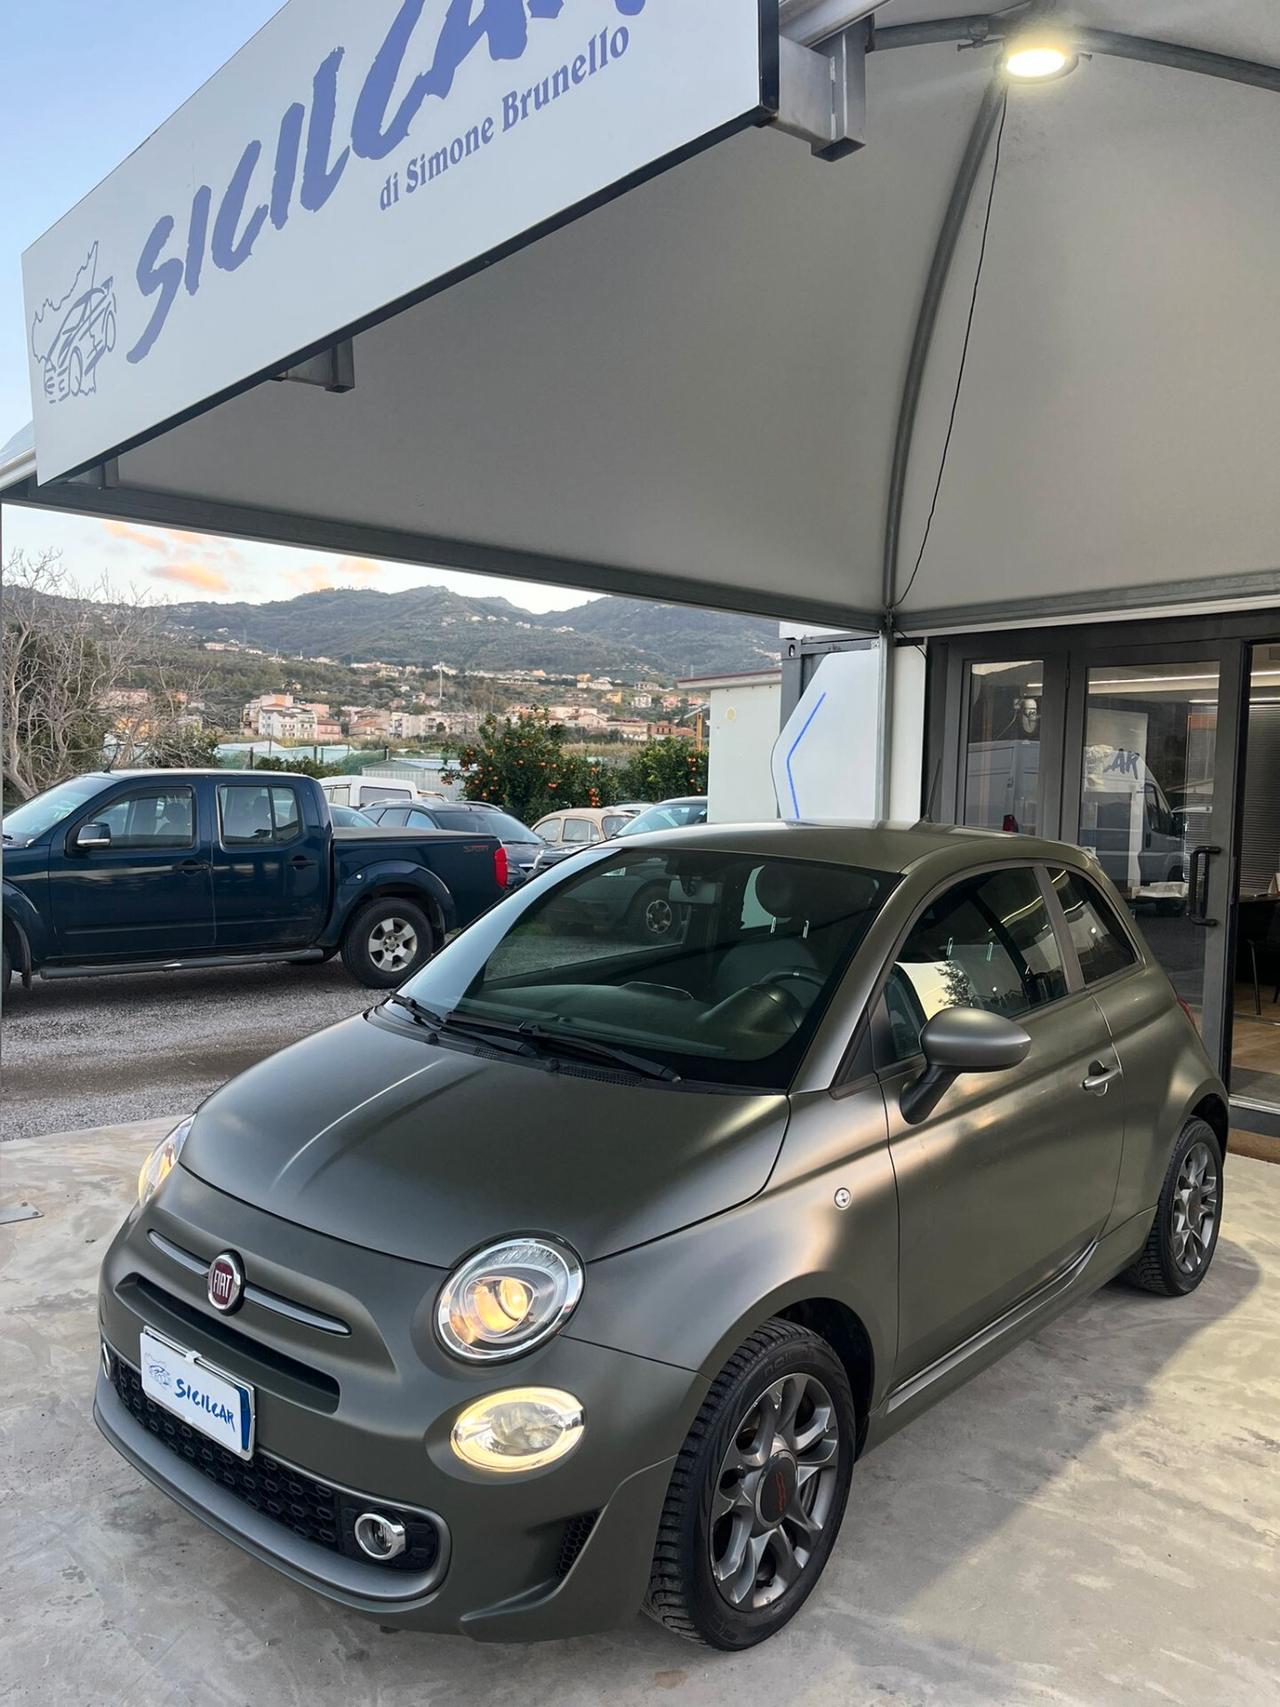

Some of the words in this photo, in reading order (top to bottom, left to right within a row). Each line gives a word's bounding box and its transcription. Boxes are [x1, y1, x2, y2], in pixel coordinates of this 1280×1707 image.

[379, 172, 400, 211] di
[405, 116, 495, 194] Simone
[502, 25, 630, 132] Brunello
[212, 1269, 233, 1298] FIAT
[175, 1378, 235, 1432] SICILCAR
